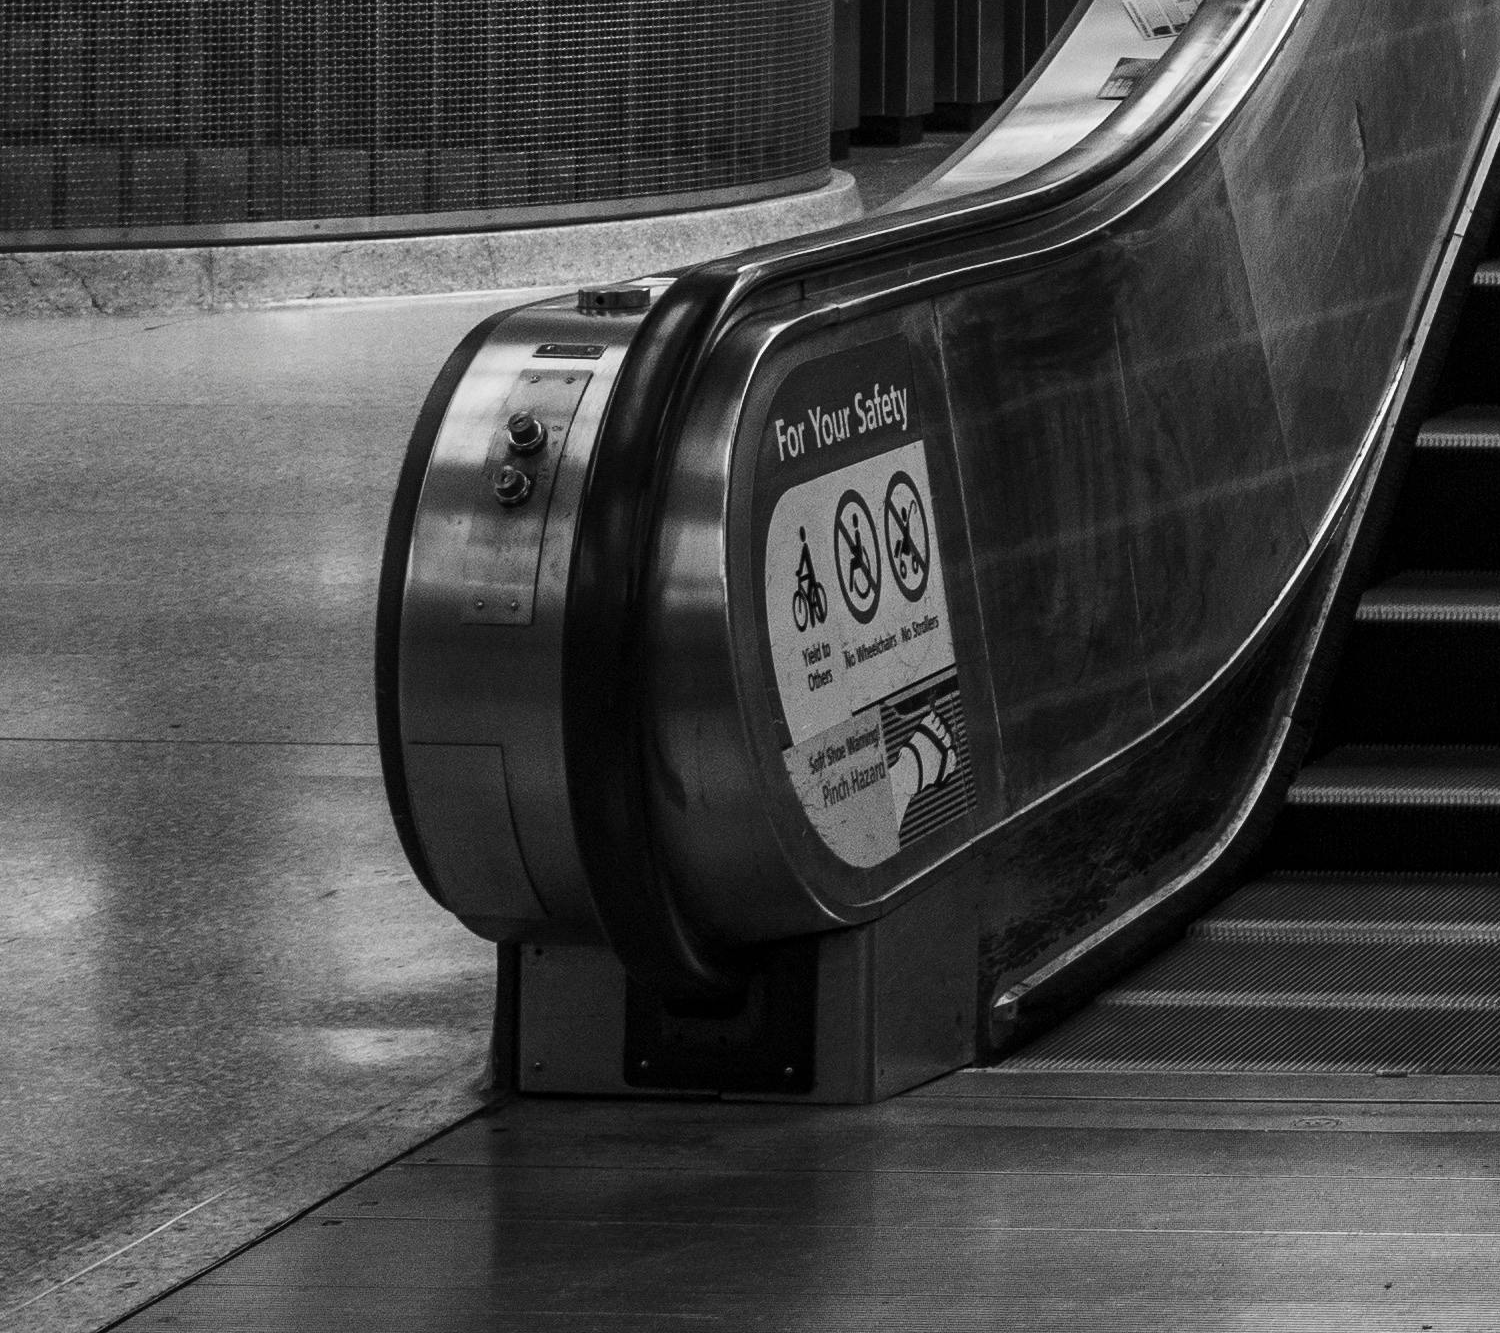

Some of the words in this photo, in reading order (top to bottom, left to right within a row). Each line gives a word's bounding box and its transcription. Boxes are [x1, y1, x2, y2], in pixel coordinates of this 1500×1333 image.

[775, 418, 805, 462] For
[808, 406, 851, 448] Your
[854, 383, 907, 433] Safety
[901, 625, 912, 643] No
[912, 614, 940, 639] Strollers
[802, 642, 822, 667] Yield
[822, 642, 832, 659] to
[843, 650, 857, 670] No
[856, 634, 898, 664] Wheelchairs
[808, 669, 833, 692] Others
[808, 749, 827, 775] Soft
[826, 744, 847, 767] Shoe
[822, 773, 851, 808] Pinch
[850, 757, 887, 794] Hazard
